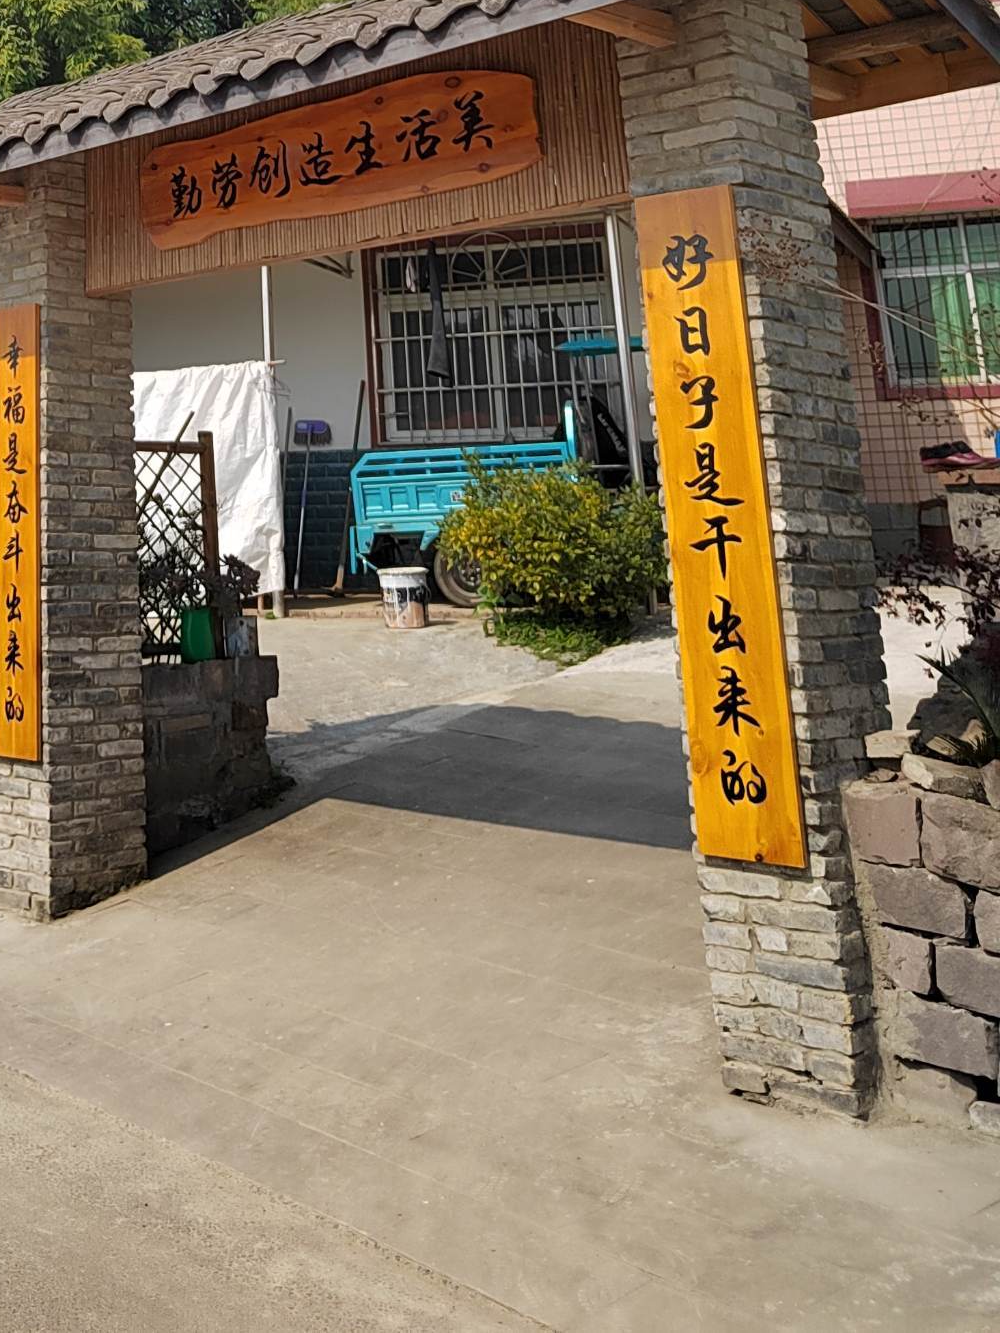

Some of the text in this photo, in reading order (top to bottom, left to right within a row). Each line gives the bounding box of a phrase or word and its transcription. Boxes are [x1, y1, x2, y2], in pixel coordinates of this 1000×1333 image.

[170, 90, 495, 219] 勤劳创造生活美
[1, 334, 29, 724] 幸福是奋斗出来的
[662, 234, 768, 806] 好日子是干出来的
